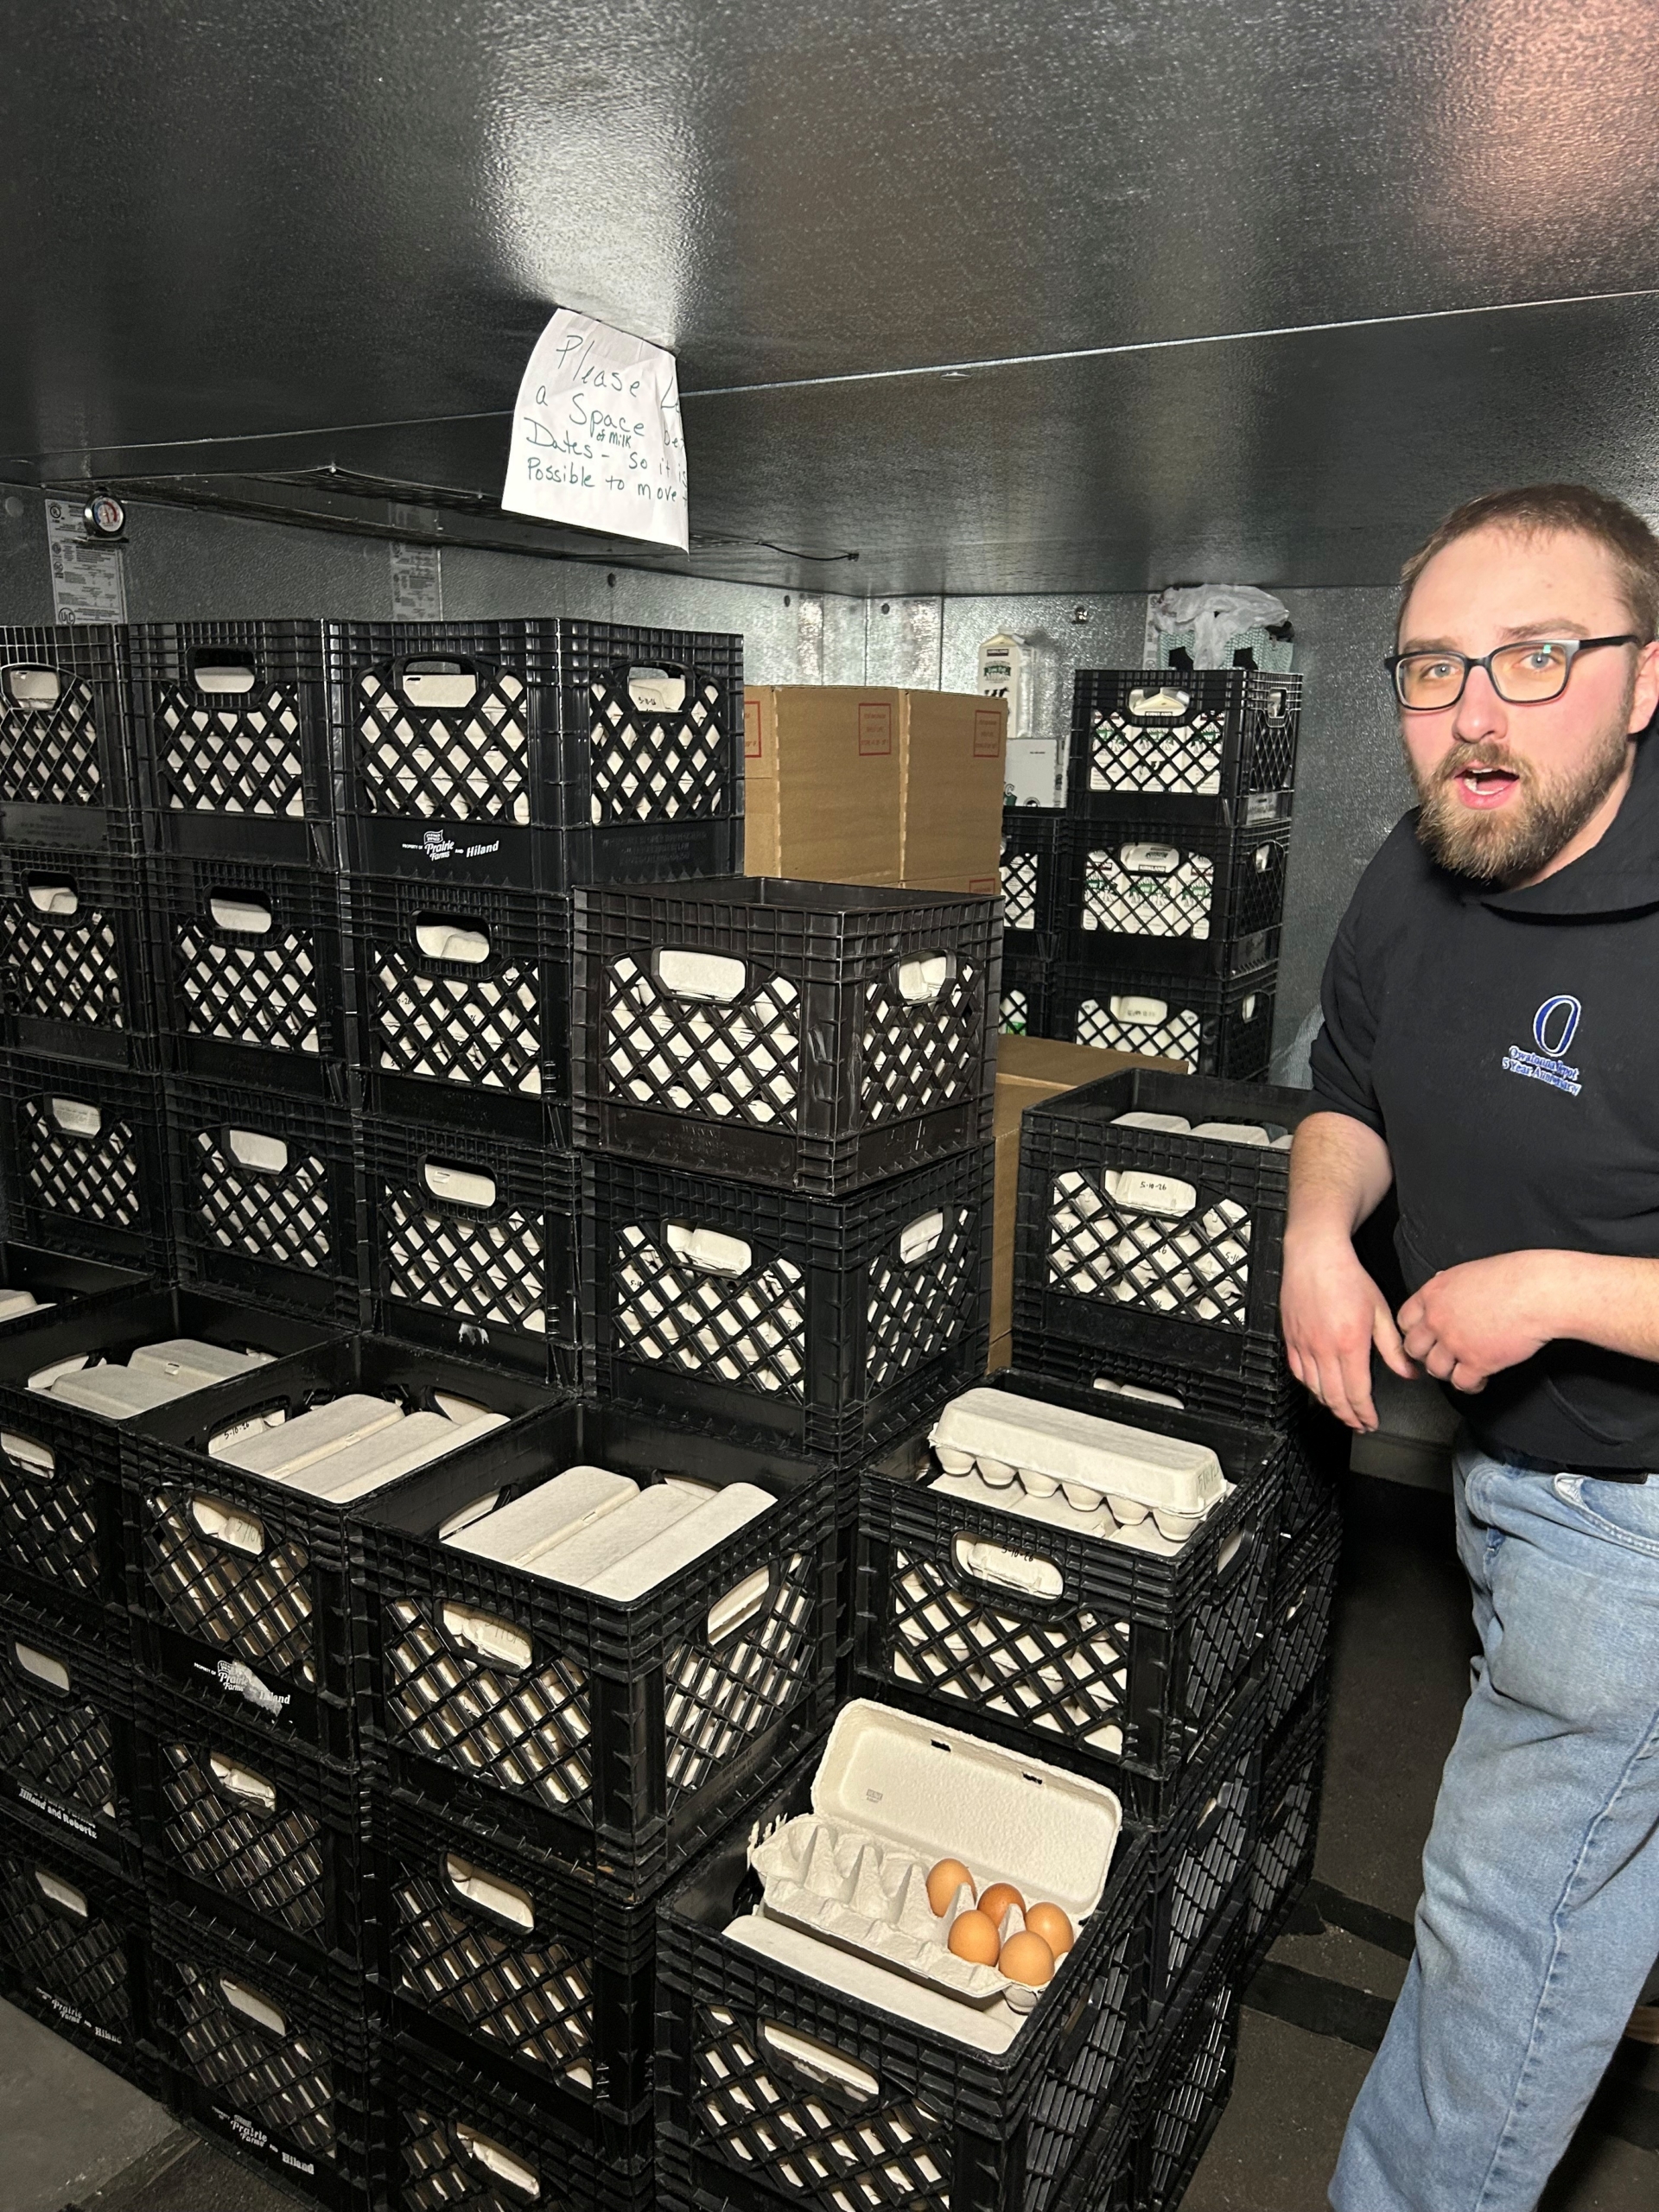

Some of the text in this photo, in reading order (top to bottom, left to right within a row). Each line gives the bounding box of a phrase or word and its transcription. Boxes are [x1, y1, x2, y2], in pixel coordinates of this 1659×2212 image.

[556, 334, 641, 397] Please
[536, 385, 548, 406] a
[569, 393, 645, 437] Space
[596, 429, 606, 442] of
[527, 457, 595, 488] Possible
[606, 475, 625, 490] to
[424, 840, 454, 855] Prairie
[467, 841, 499, 858] Hiland
[429, 851, 450, 861] Farms
[1503, 1057, 1510, 1070] 5
[218, 1672, 249, 1686] Prairie
[47, 1806, 62, 1820] and
[230, 2120, 268, 2143] Prairie
